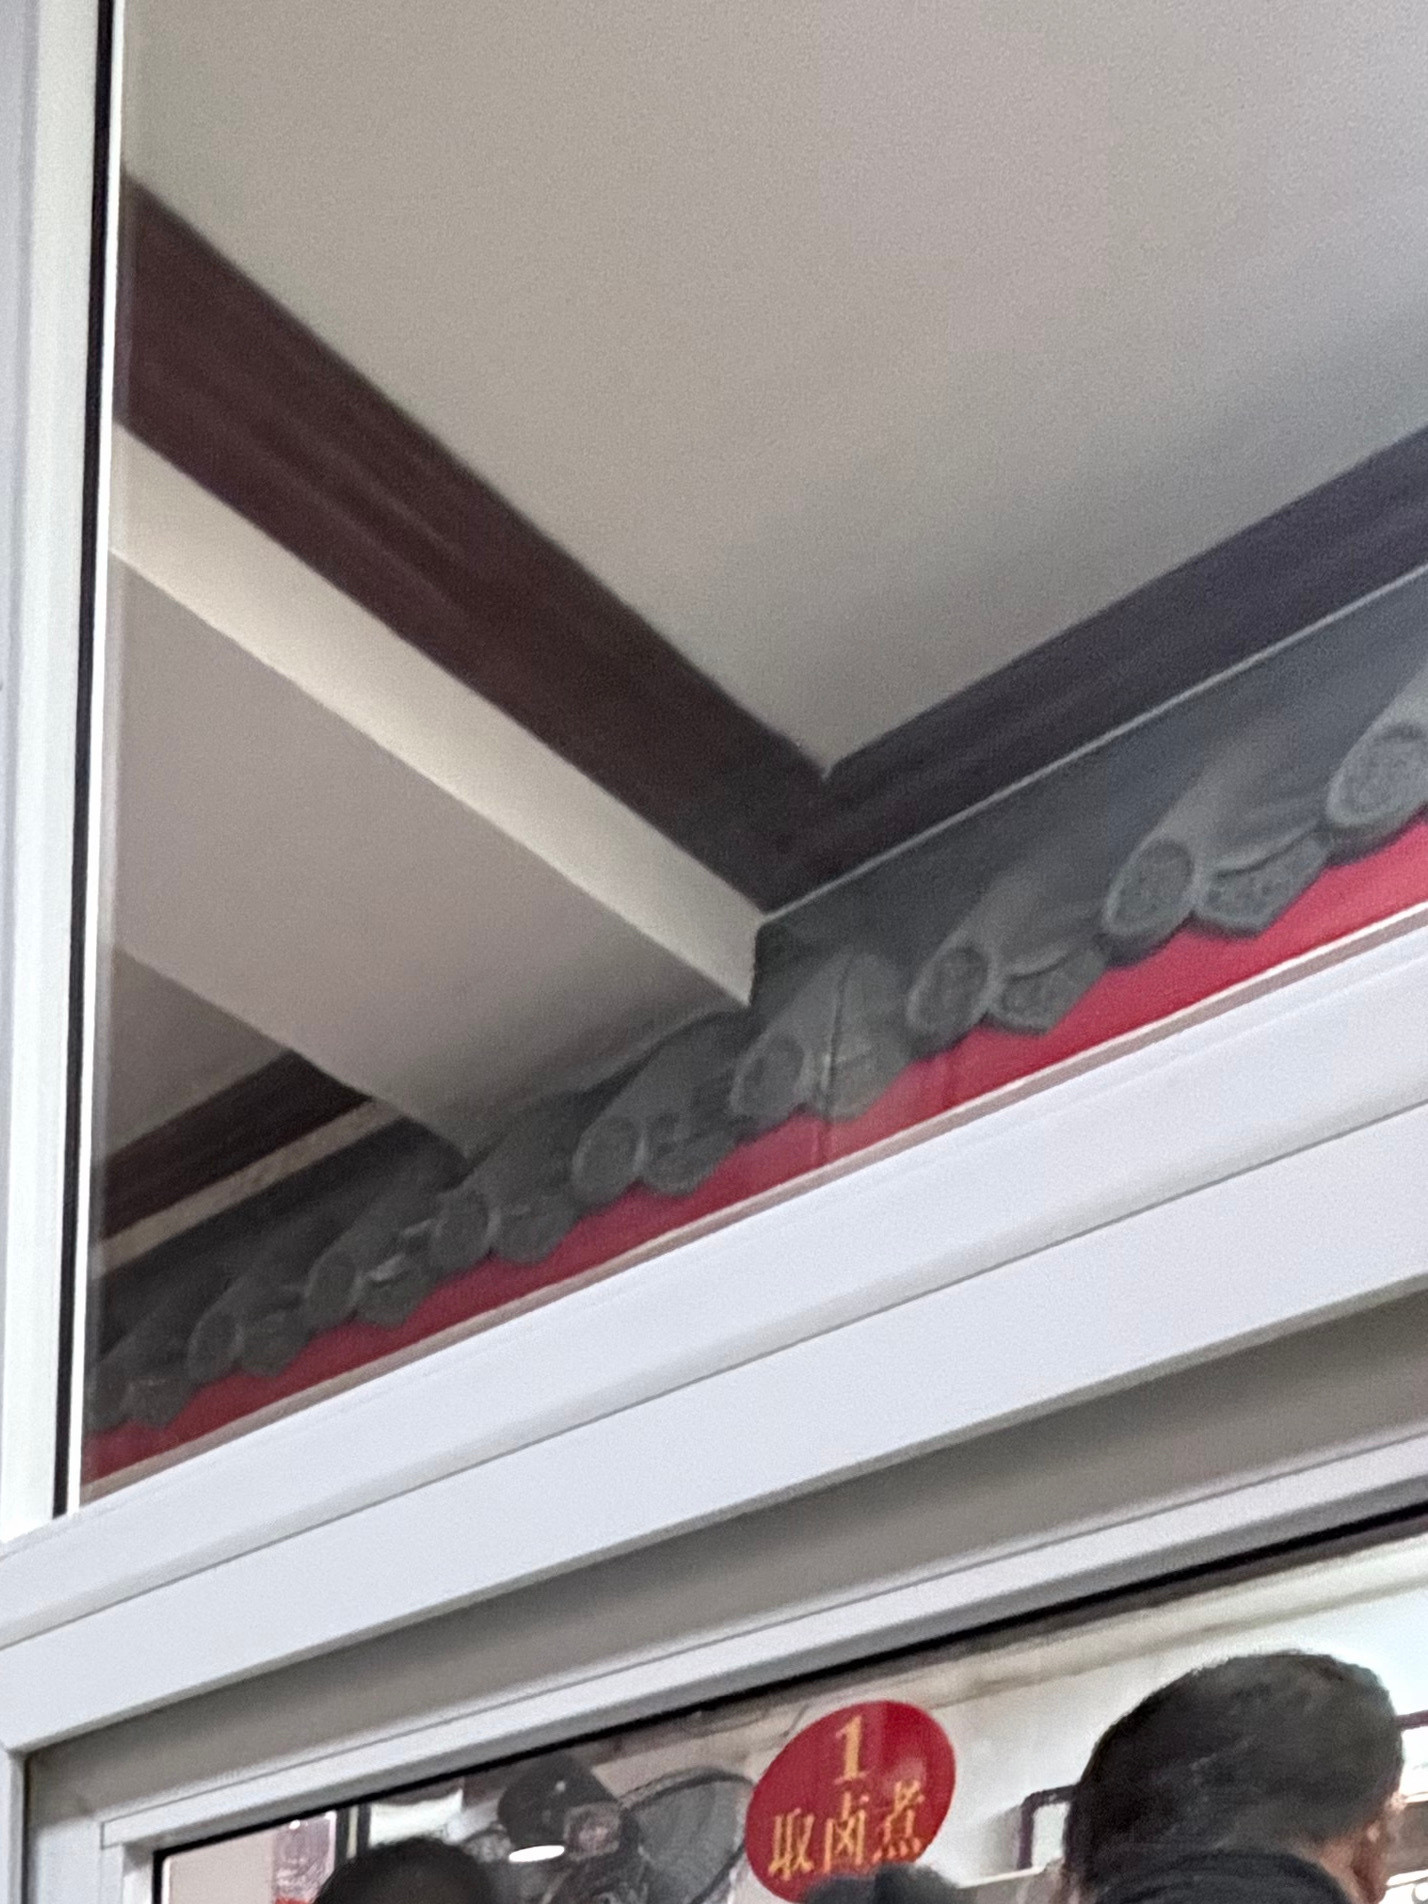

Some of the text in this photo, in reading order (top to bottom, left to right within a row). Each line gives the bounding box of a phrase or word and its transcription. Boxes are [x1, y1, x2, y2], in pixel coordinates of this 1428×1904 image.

[834, 1715, 868, 1785] 1
[767, 1779, 925, 1882] 取卤煮
